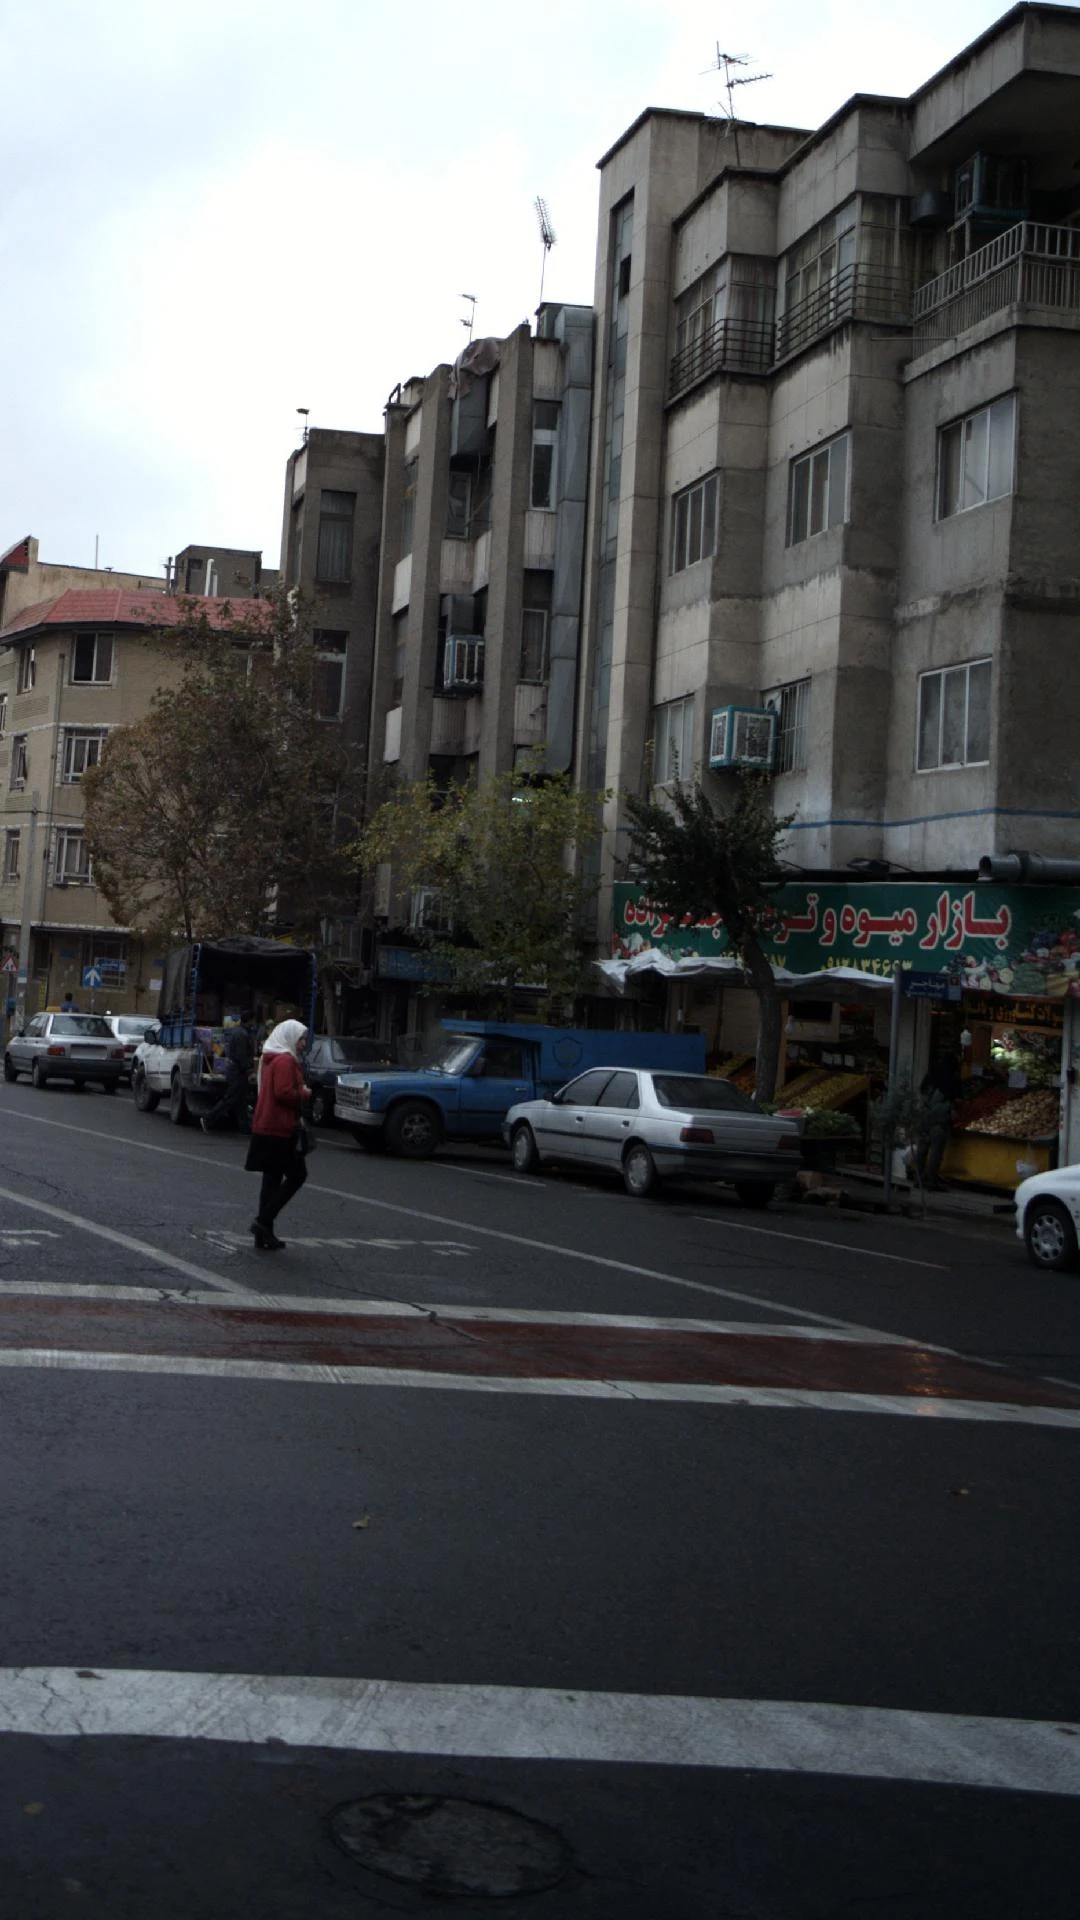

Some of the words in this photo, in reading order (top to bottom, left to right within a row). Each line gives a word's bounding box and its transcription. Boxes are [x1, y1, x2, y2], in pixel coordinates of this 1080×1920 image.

[819, 907, 838, 946] و
[840, 904, 917, 947] میوه
[918, 889, 1012, 950] بازار
